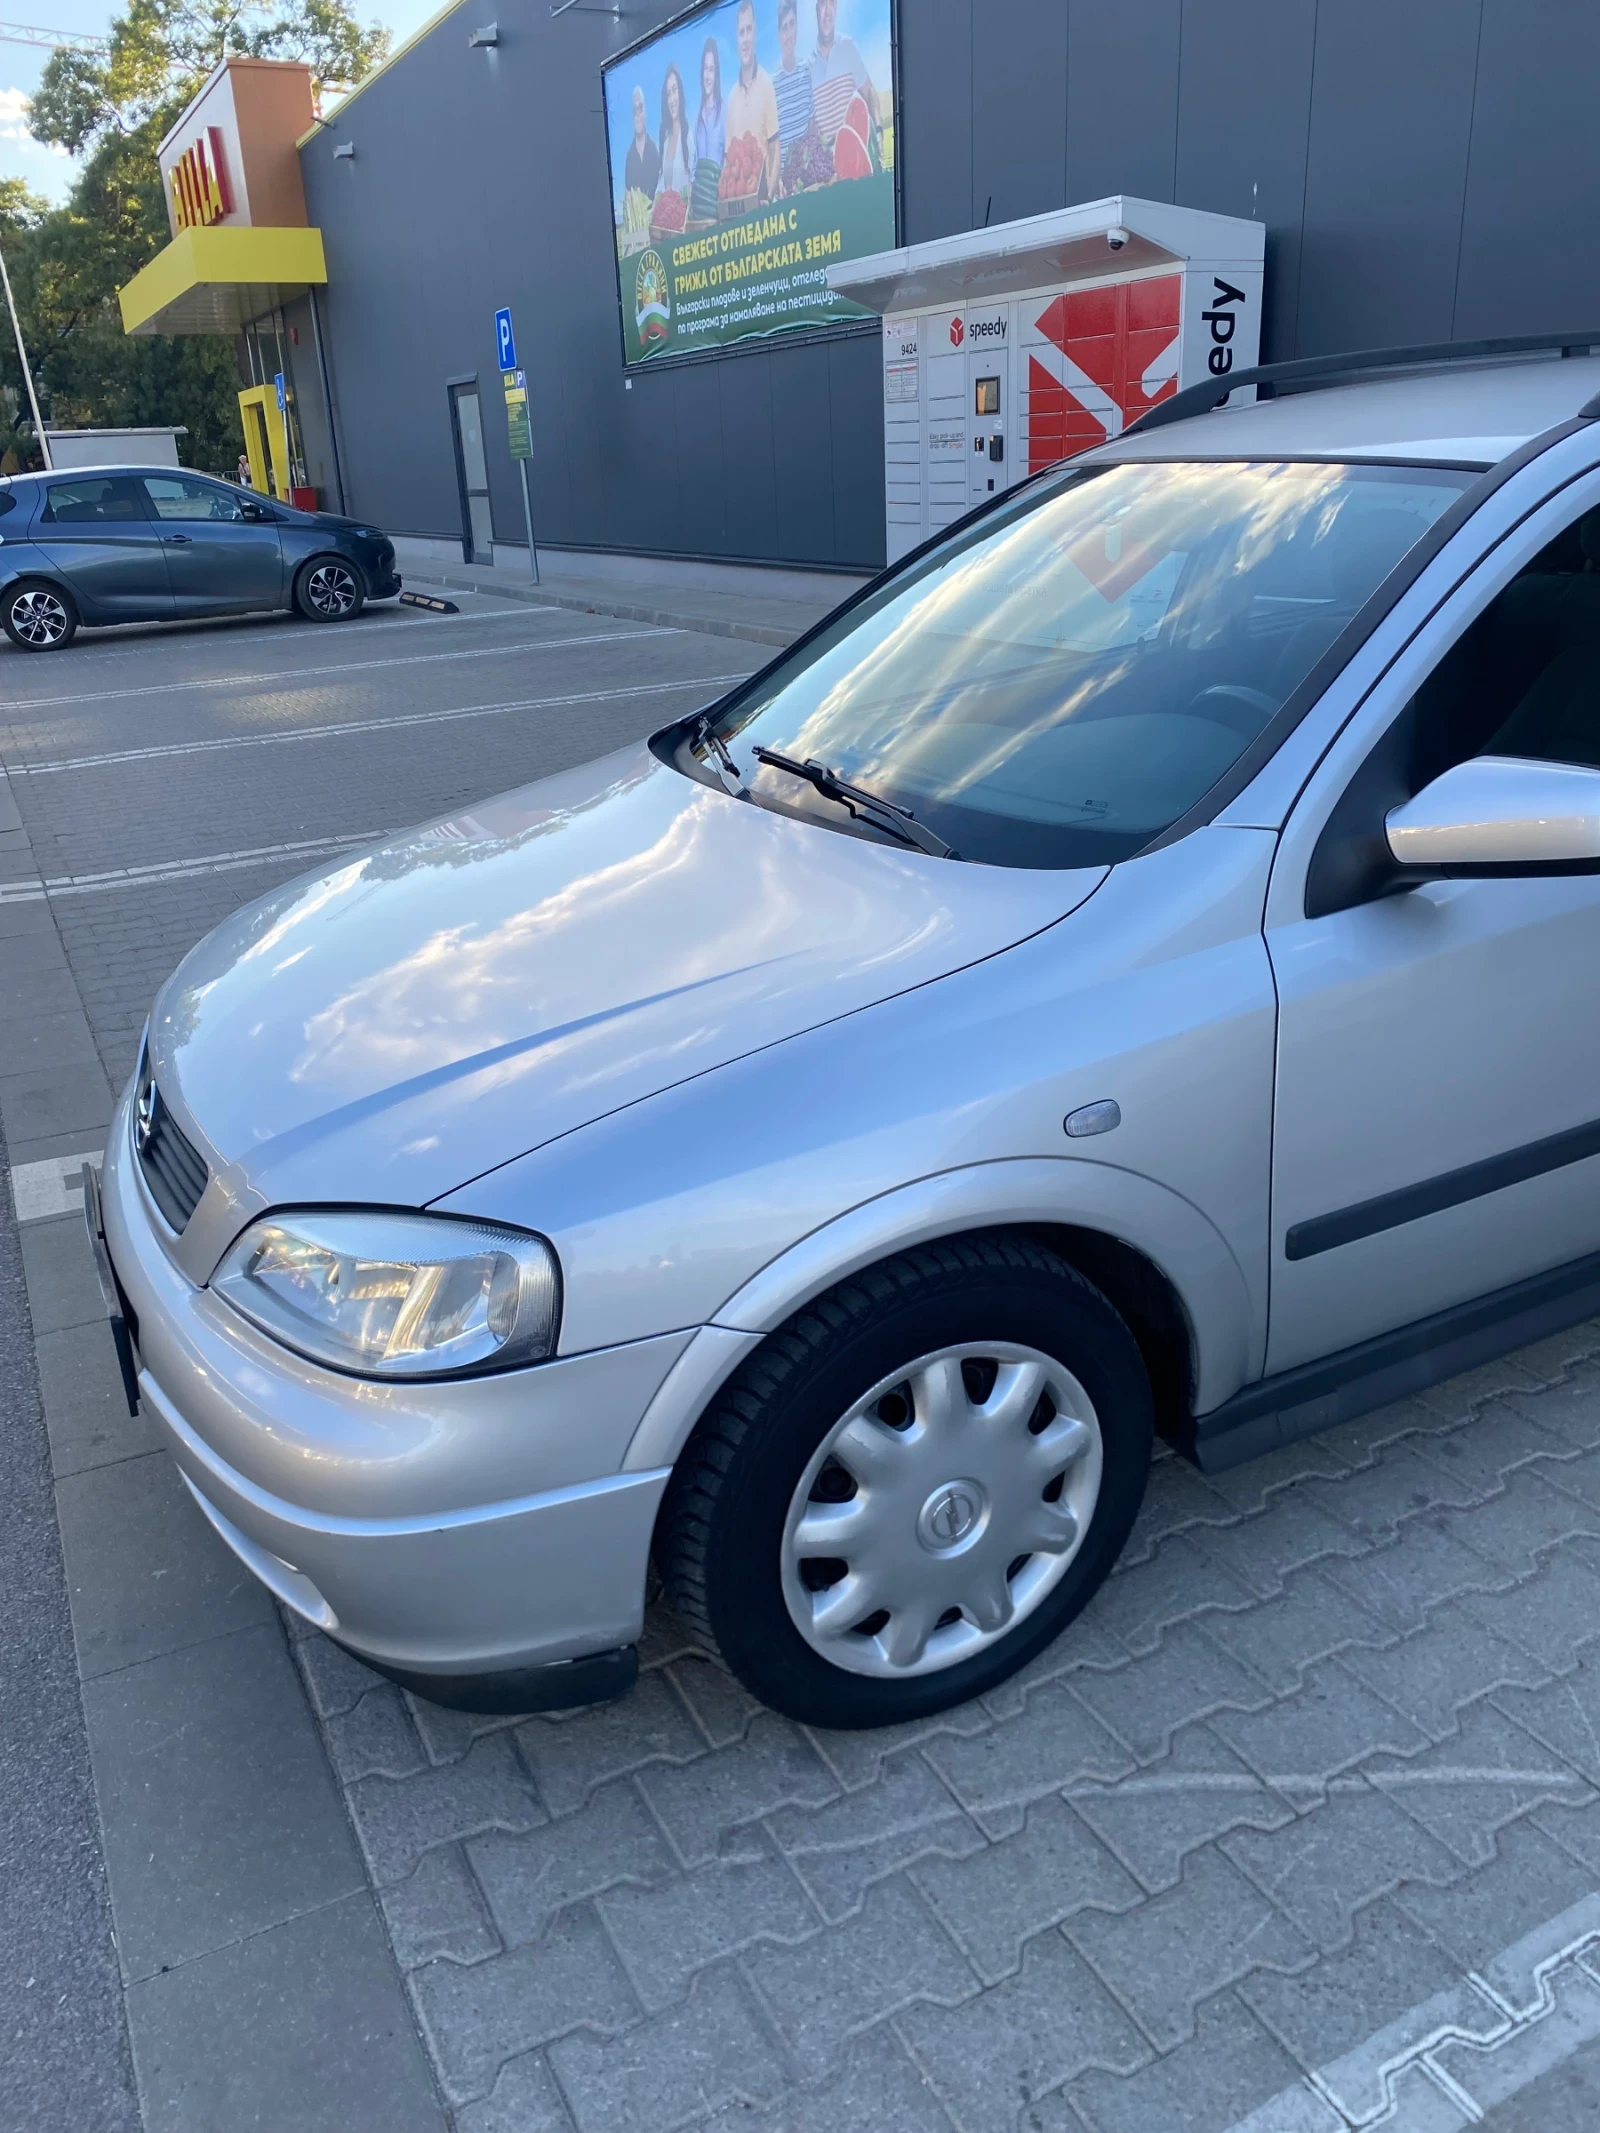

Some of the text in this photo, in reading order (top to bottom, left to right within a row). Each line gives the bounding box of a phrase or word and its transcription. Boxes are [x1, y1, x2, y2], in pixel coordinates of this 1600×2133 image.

[168, 126, 230, 232] BILLA
[672, 234, 719, 267] СВЕЖЕСТ
[720, 212, 787, 252] ОТГЛЕДАНА
[788, 208, 798, 230] С
[674, 229, 841, 296] ГРИЖА ОТ БЪЛГАРСКАТА ЗЕМЯ
[676, 296, 710, 316] Български
[711, 287, 741, 308] плодове
[741, 288, 747, 300] и
[747, 278, 791, 302] зеленчуци,
[677, 290, 845, 335] по програма за намаляване на пестициди
[499, 318, 510, 362] P
[901, 343, 917, 356] 9424
[969, 316, 1008, 341] speedy
[1201, 276, 1246, 408] edy
[517, 372, 523, 386] P
